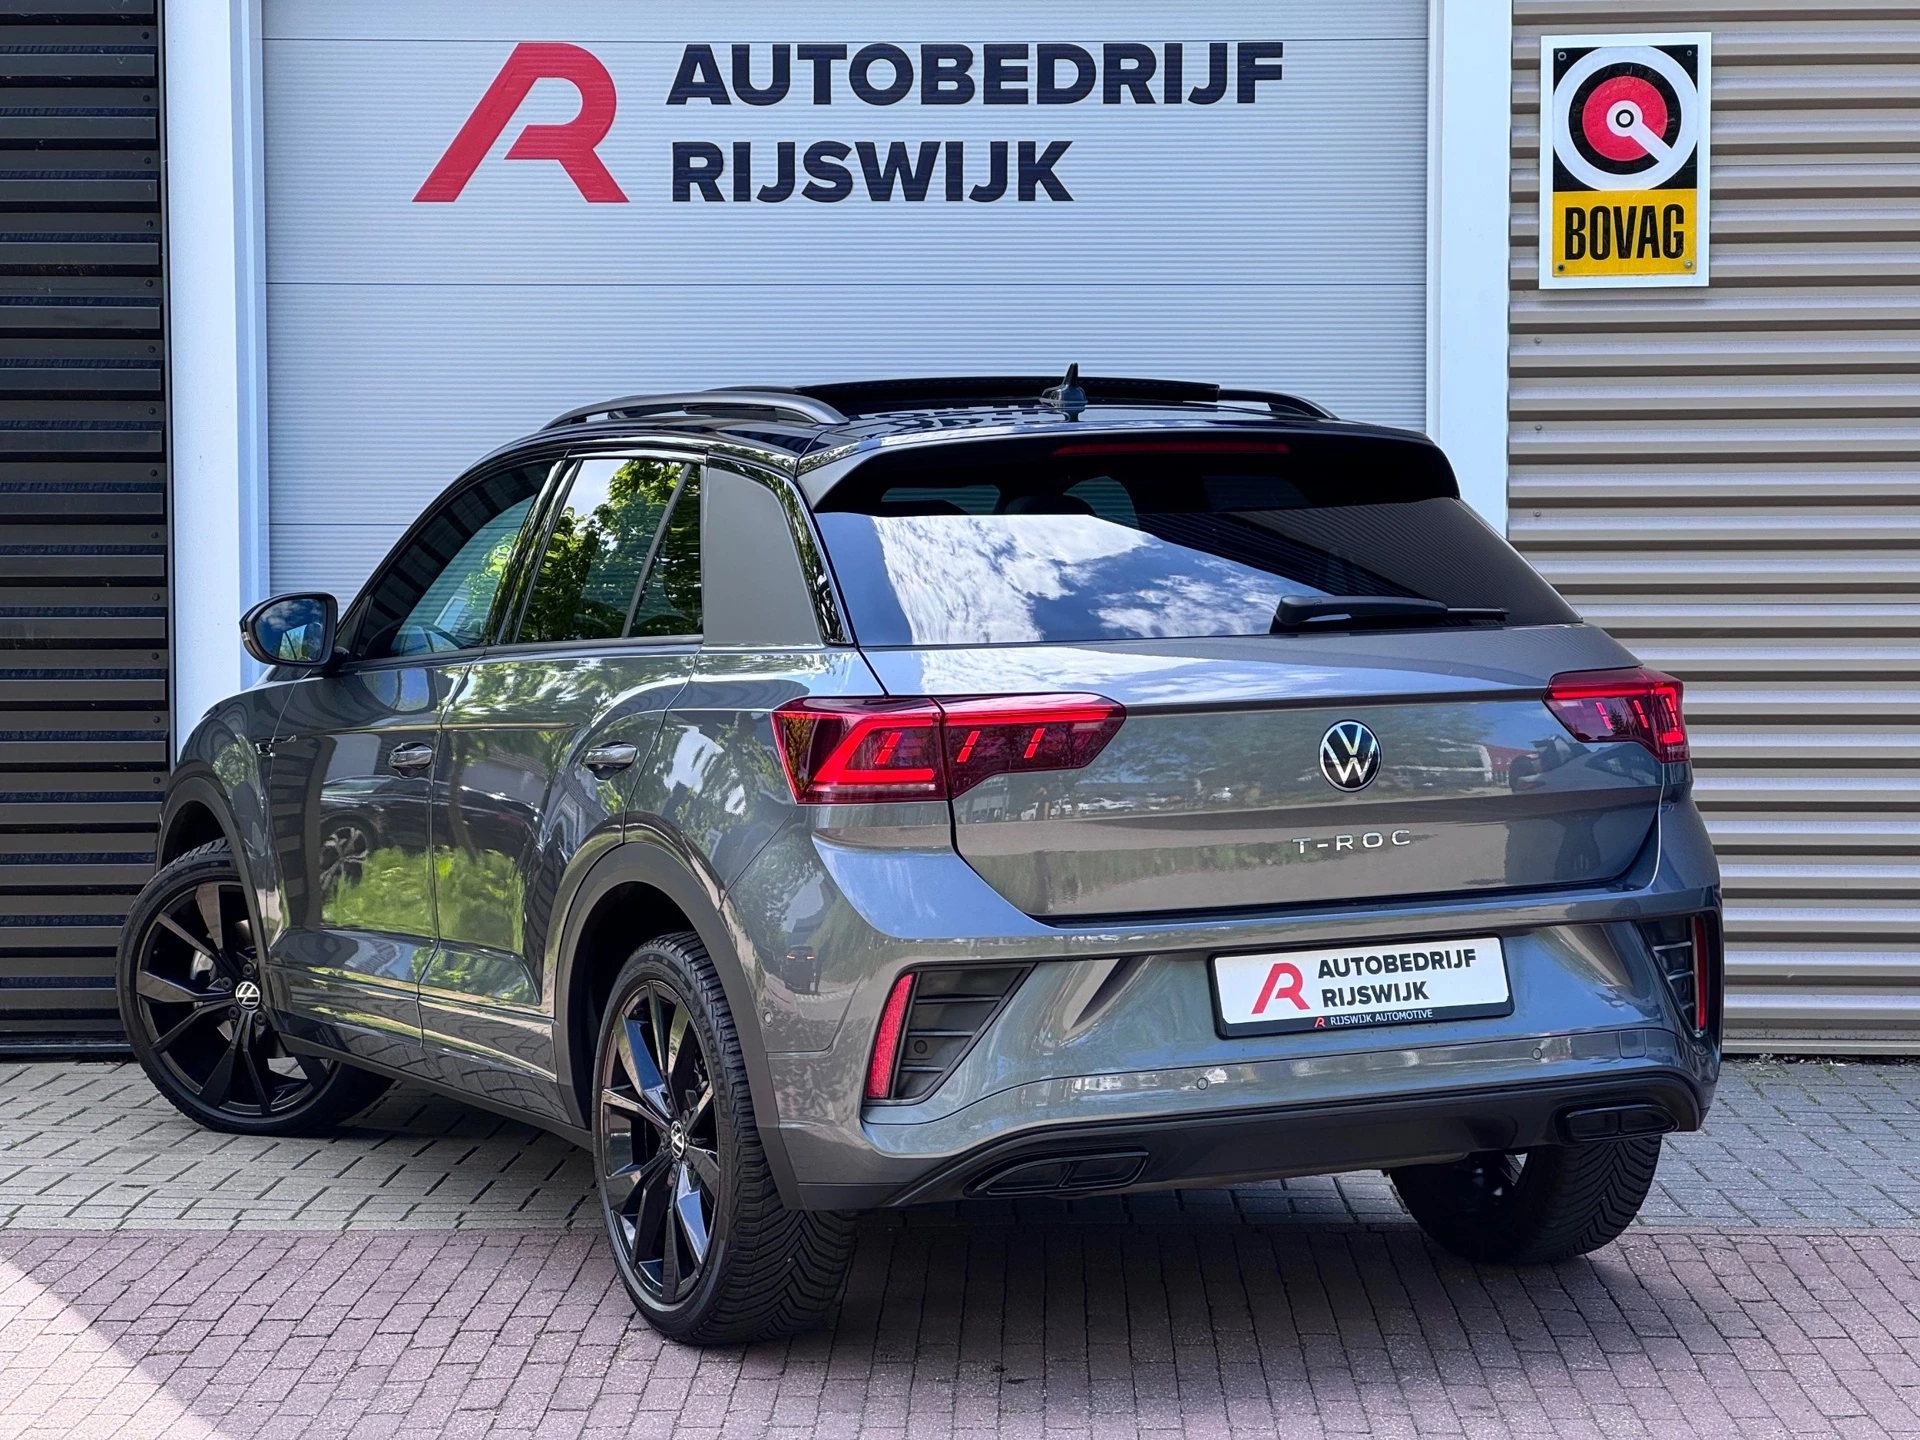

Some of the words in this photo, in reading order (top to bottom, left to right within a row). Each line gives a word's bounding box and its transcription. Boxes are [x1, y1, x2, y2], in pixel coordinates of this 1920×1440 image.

[666, 42, 1284, 106] AUTOBEDRIJF
[671, 140, 1076, 203] RIJSWIJK
[1565, 203, 1685, 261] BOVAG
[1292, 829, 1411, 854] T-ROC
[1318, 948, 1477, 979] AUTOBEDRIJF
[1322, 981, 1430, 1008] RIJSWIJK
[1330, 1013, 1373, 1026] RIJSWIJK
[1375, 1009, 1434, 1023] AUTOMOTIVE
